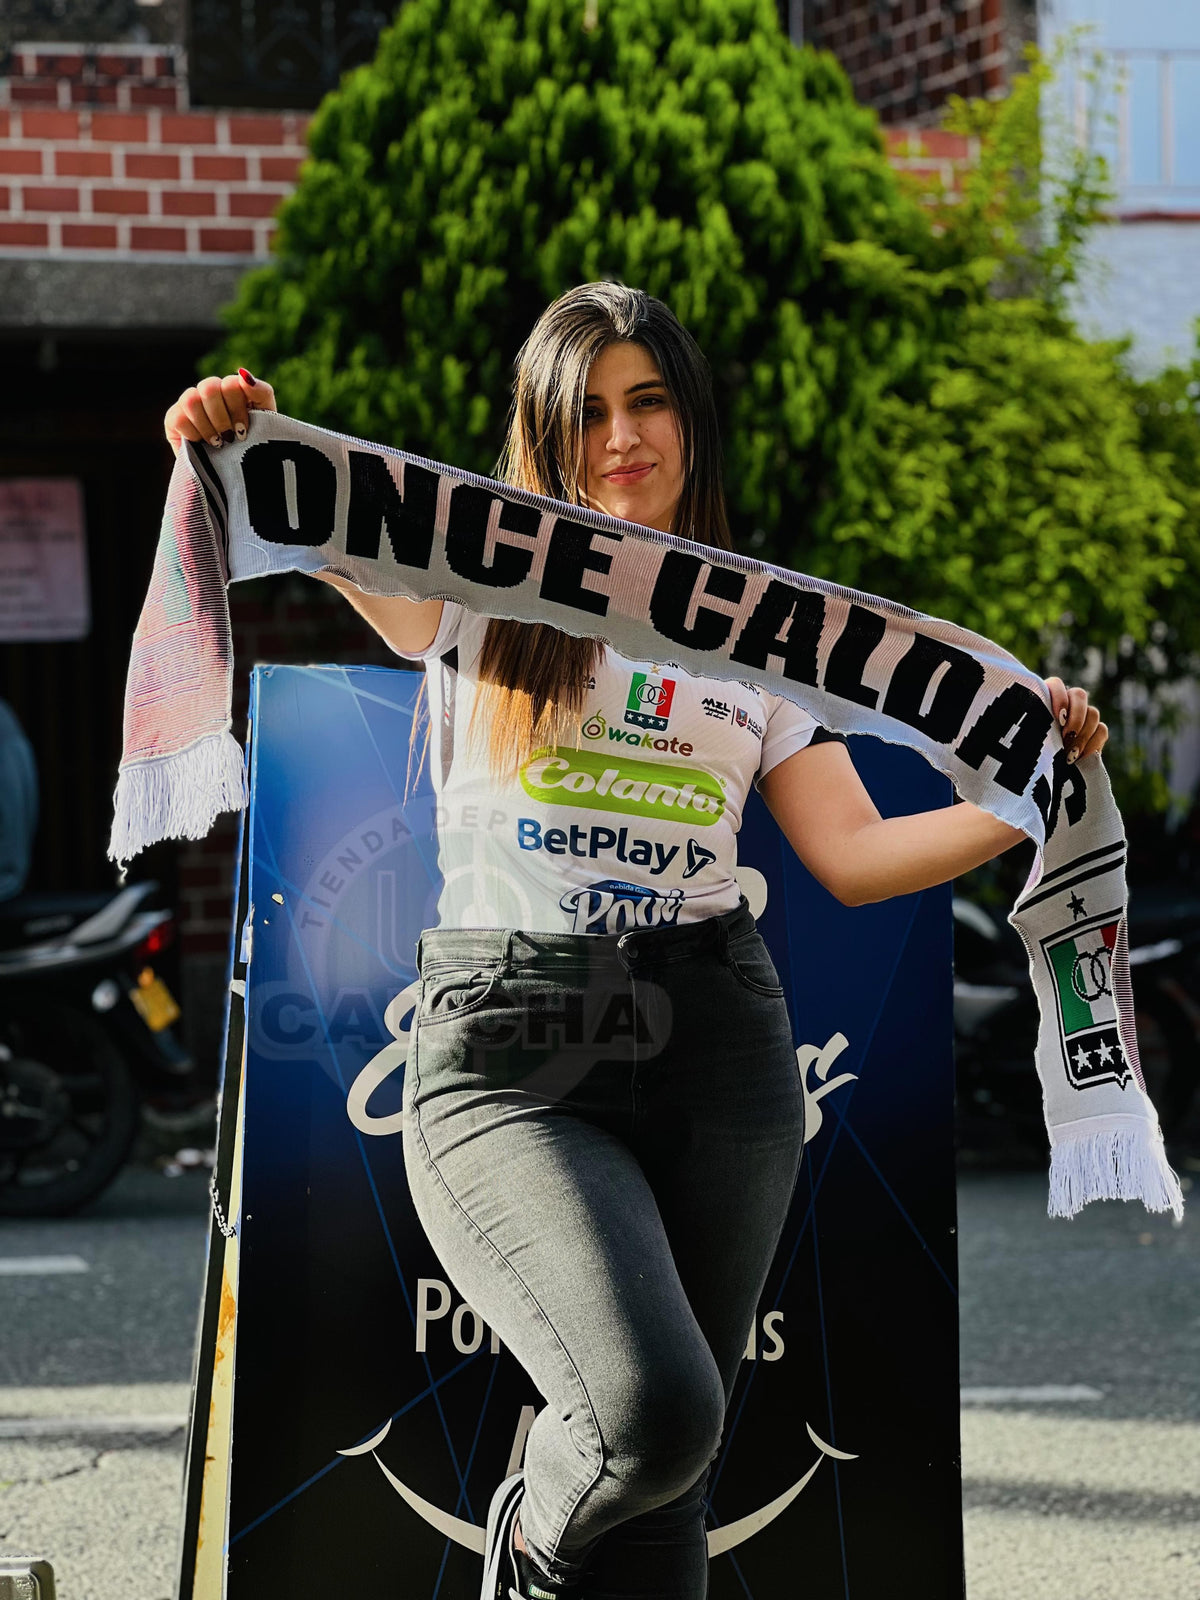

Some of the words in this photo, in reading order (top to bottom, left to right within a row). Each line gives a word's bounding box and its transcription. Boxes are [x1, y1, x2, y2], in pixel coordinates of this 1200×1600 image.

[241, 439, 624, 617] ONCE
[701, 697, 731, 713] MZL
[608, 725, 694, 757] wakate
[525, 756, 726, 815] Colanta
[517, 817, 680, 875] BetPlay
